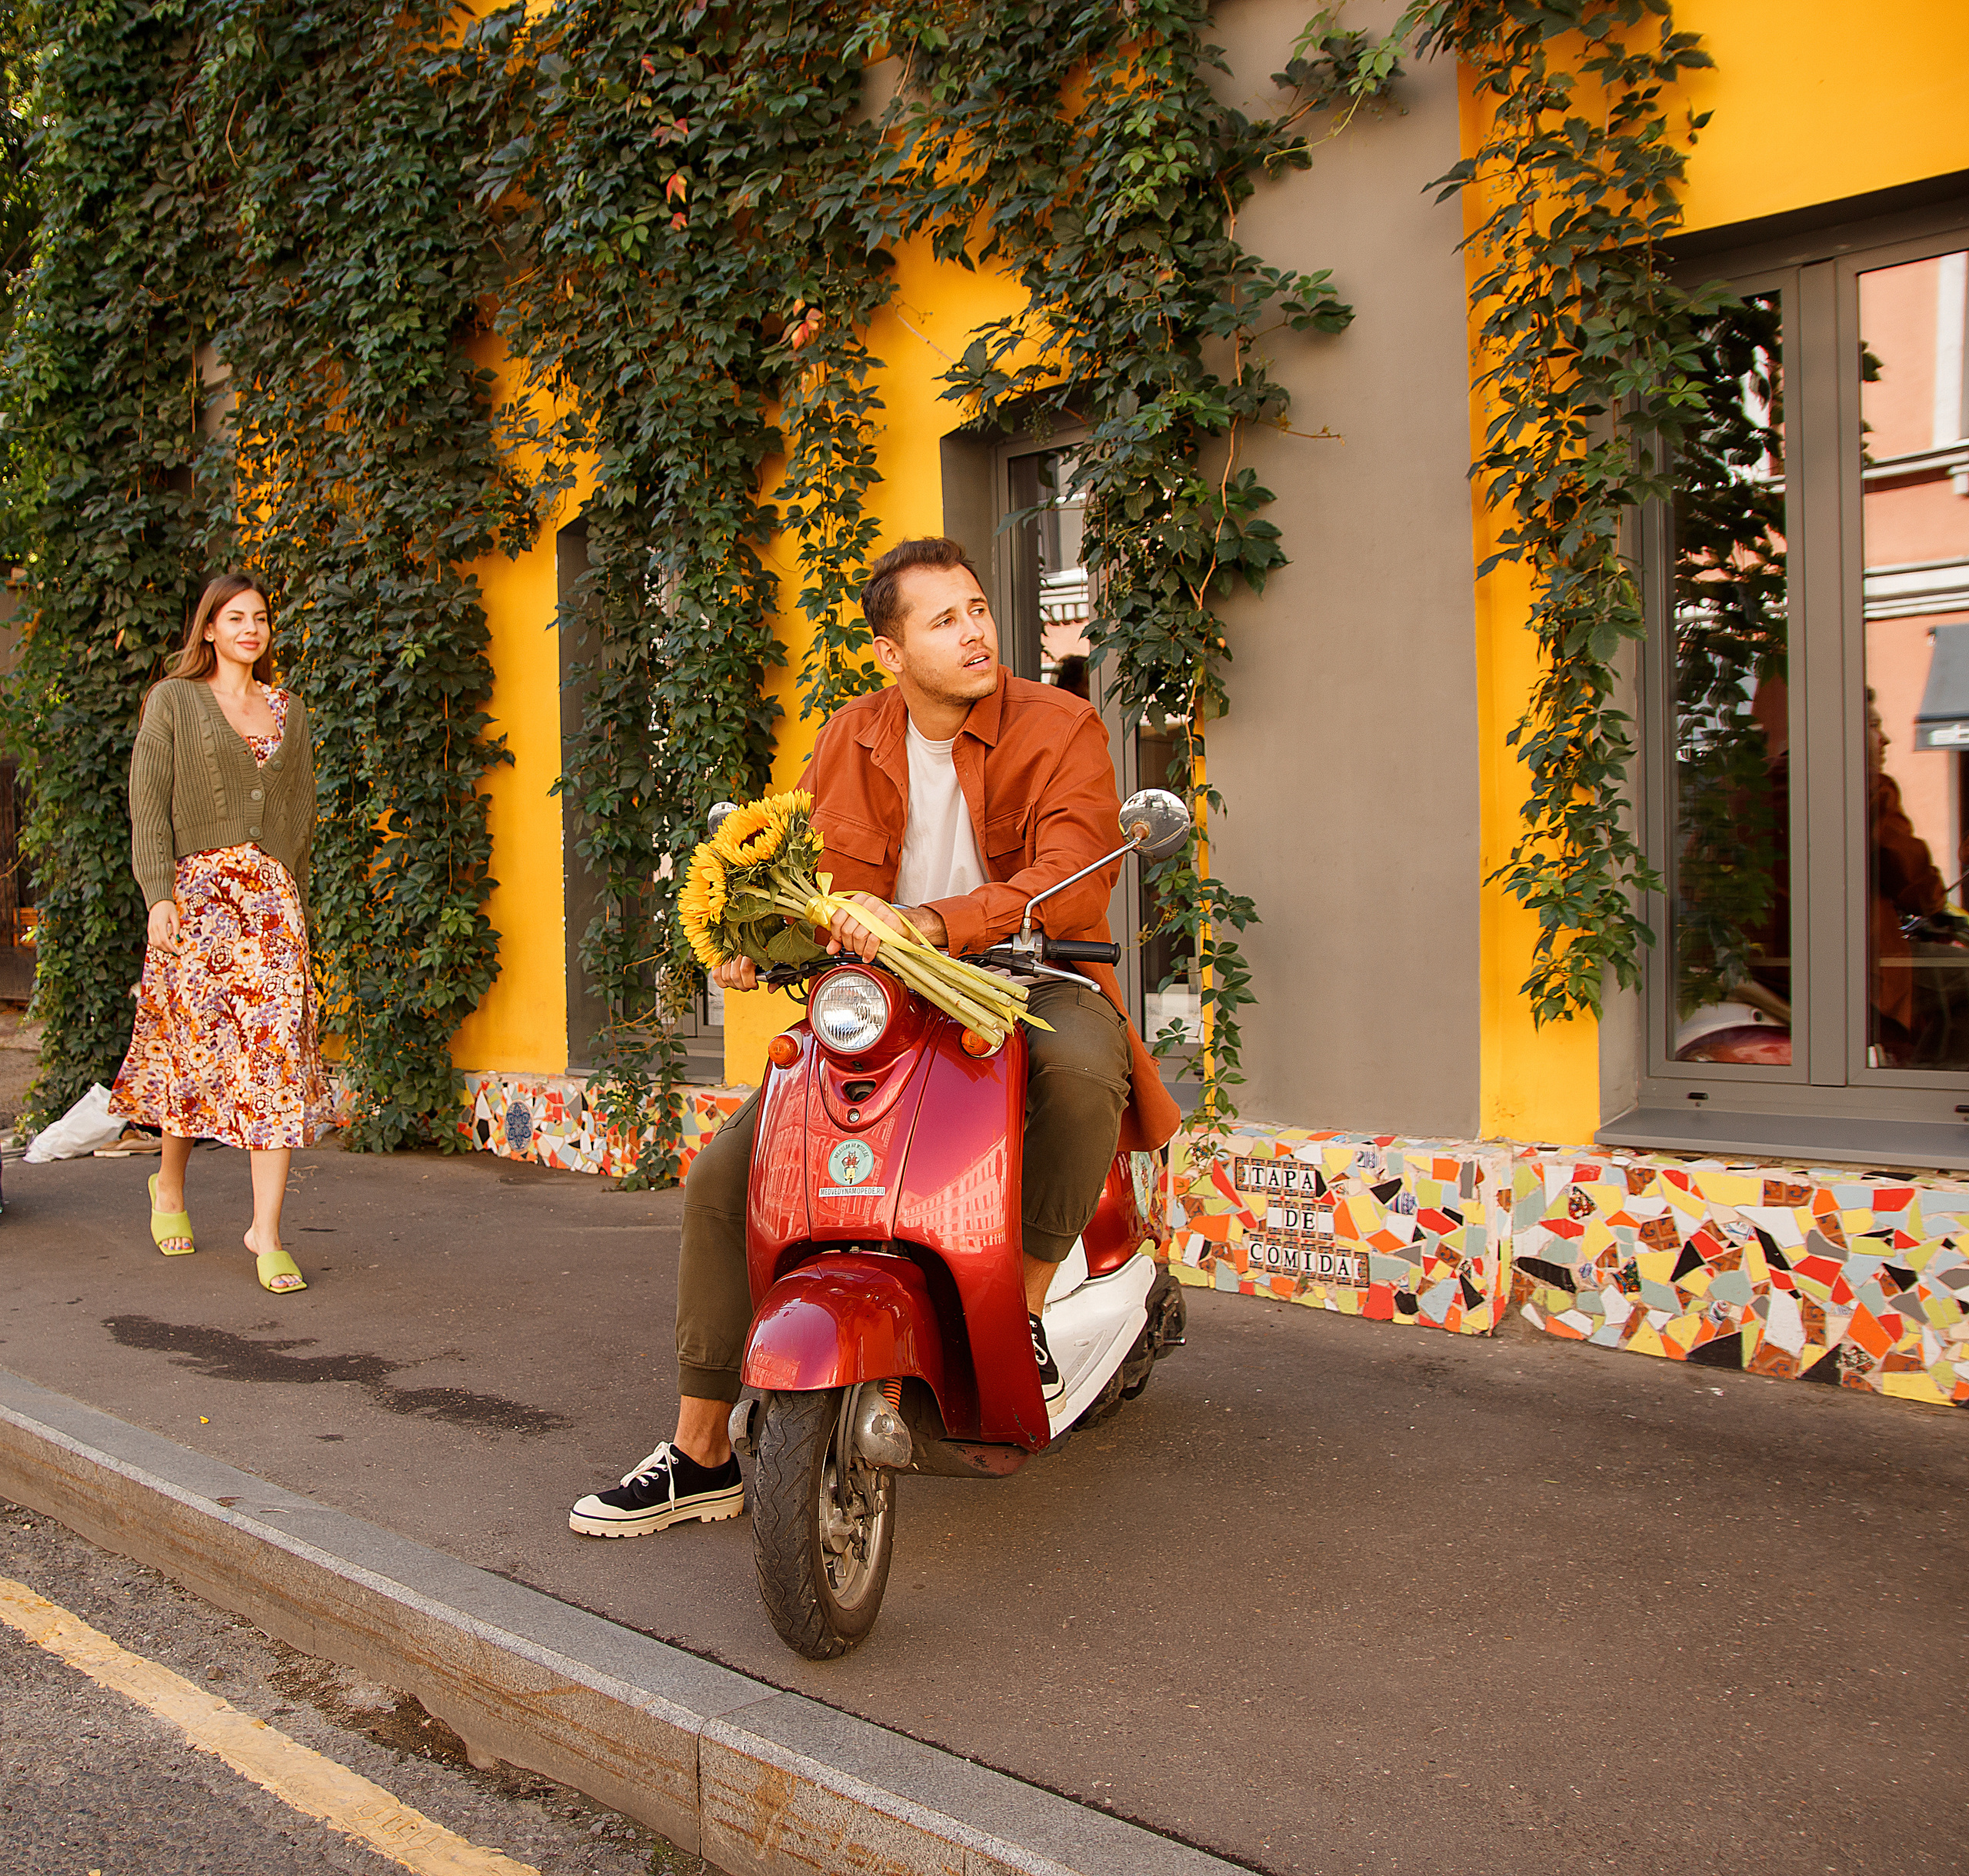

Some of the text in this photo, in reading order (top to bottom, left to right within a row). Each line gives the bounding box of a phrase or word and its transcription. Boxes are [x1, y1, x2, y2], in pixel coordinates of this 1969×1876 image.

[1252, 1167, 1314, 1190] TAPA
[820, 1187, 885, 1195] MEDVEDYNAMOPEDE.RU
[1285, 1209, 1315, 1230] DE
[1250, 1243, 1350, 1276] COMIDA
